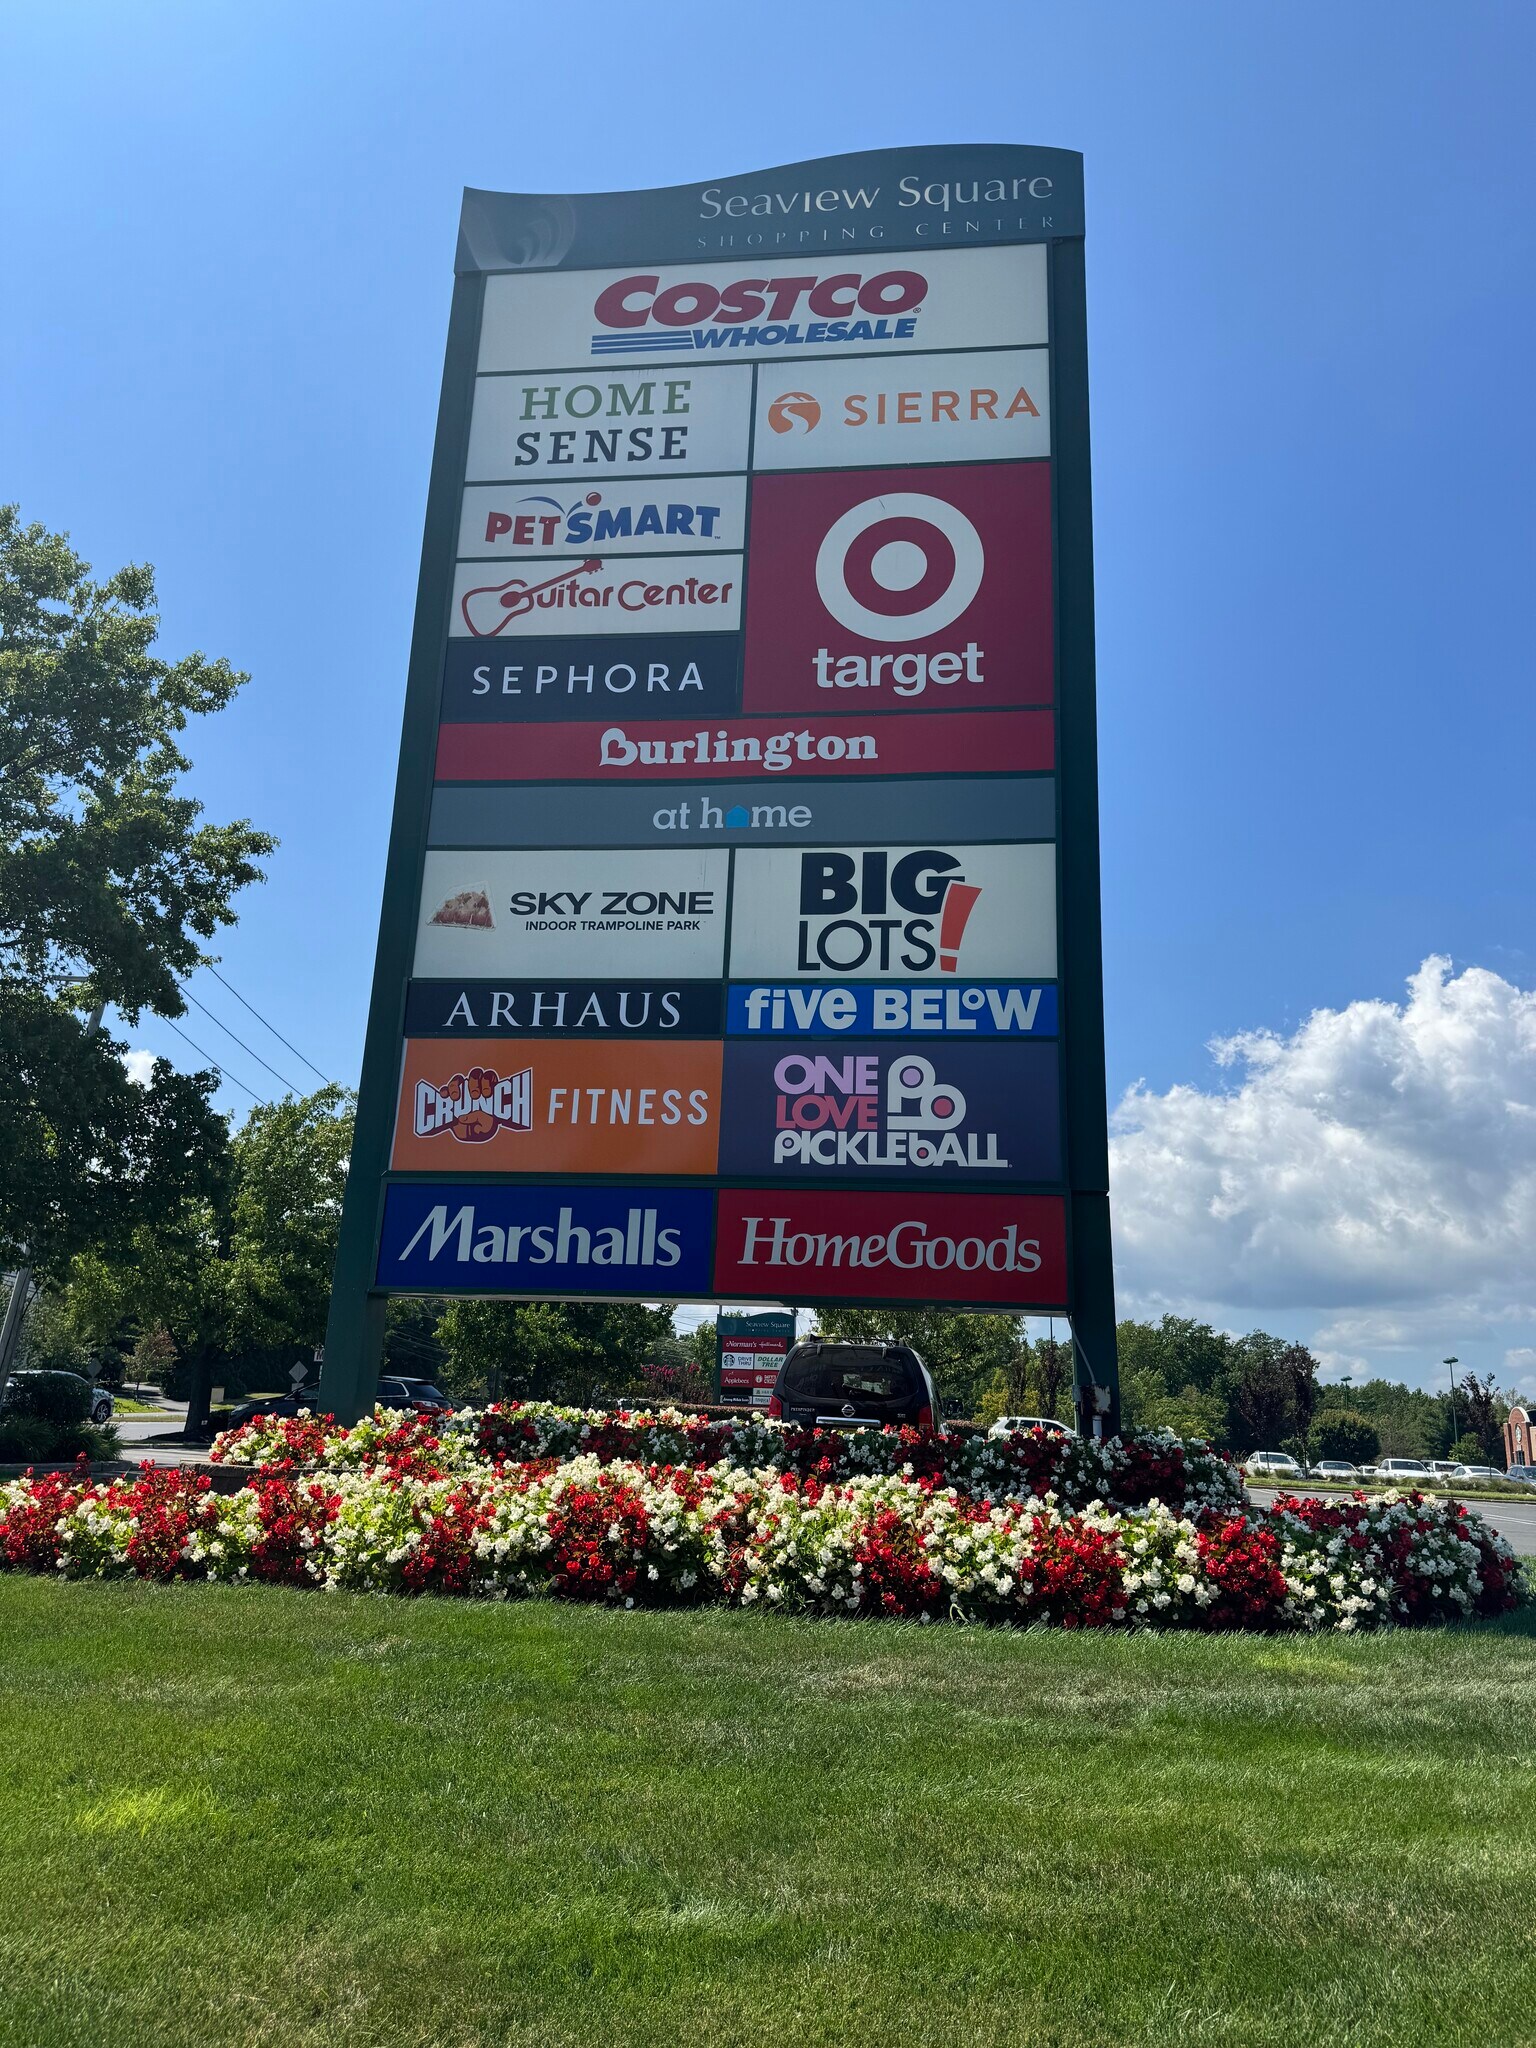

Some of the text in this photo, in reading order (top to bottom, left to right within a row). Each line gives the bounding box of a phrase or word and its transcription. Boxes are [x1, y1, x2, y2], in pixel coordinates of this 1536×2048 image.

[699, 175, 1053, 219] Seaview Square
[697, 216, 1055, 250] SHOPPING CENTER
[593, 270, 928, 329] COSTCO
[691, 318, 917, 350] WHOLESALE
[519, 380, 691, 421] HOME
[844, 387, 1041, 427] SIERRA
[514, 427, 688, 467] SENSE
[461, 559, 733, 637] Guitar Center
[471, 662, 705, 696] SEPHORA
[812, 642, 984, 697] target
[599, 727, 878, 771] Burlington
[653, 802, 690, 830] at
[799, 849, 966, 916] BIG
[509, 891, 714, 916] SKY ZONE
[525, 920, 701, 931] INDOOR TRAMPOLINE PARK
[442, 991, 681, 1029] ARHAUS
[773, 1054, 879, 1095] ONE
[414, 1067, 709, 1138] CRUNCH FITNESS
[775, 1094, 879, 1130] LOVE
[399, 1205, 682, 1267] Marshalls
[736, 1216, 1042, 1274] HomeGoods
